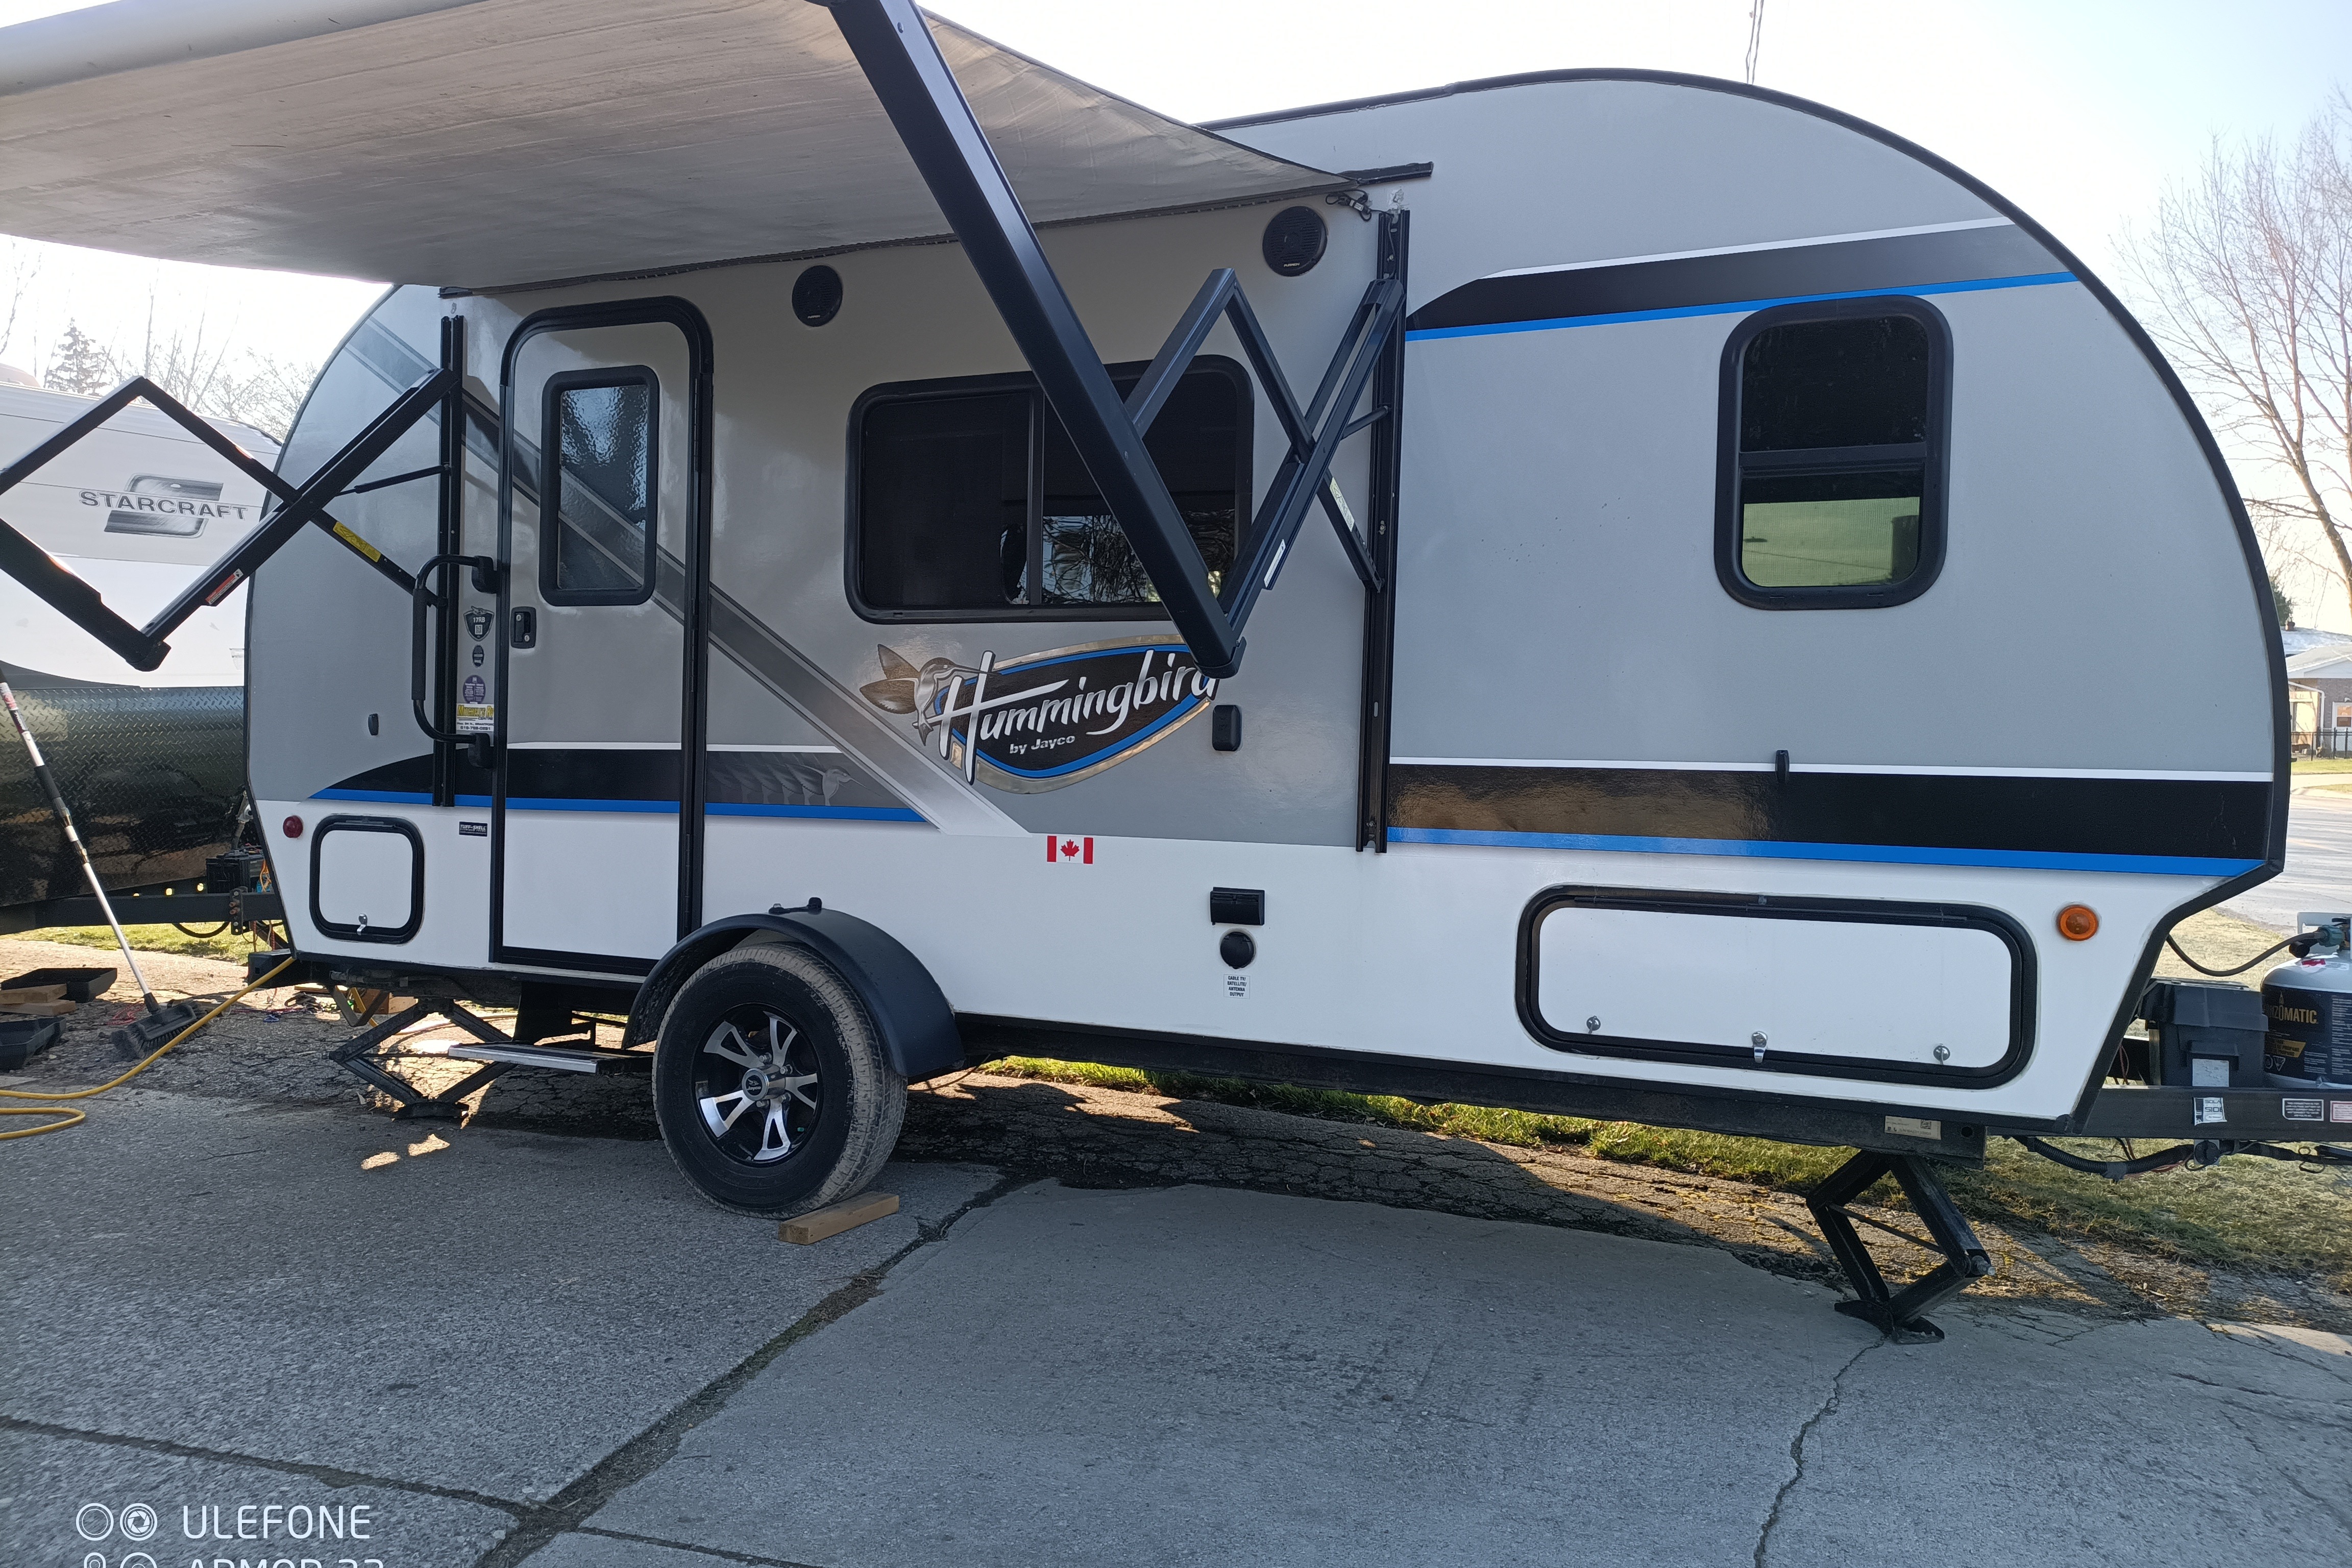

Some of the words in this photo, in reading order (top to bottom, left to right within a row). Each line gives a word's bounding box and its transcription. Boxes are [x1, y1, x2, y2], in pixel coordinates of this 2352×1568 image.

[79, 490, 248, 520] STARCRAFT
[1009, 743, 1026, 754] by
[1032, 734, 1075, 751] Jayco
